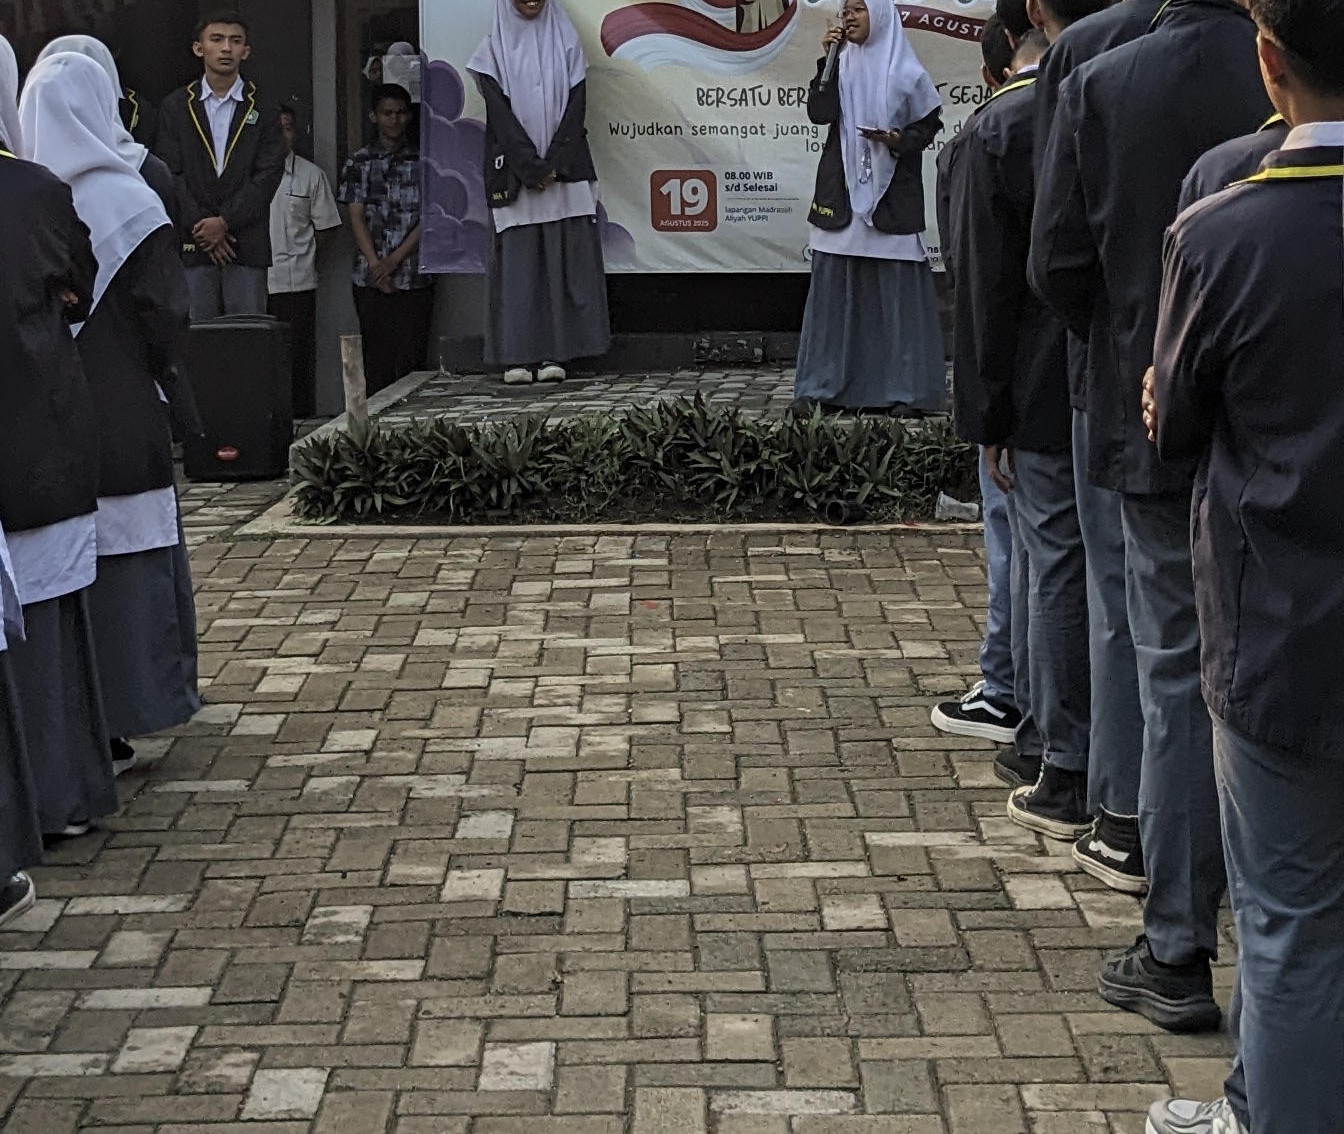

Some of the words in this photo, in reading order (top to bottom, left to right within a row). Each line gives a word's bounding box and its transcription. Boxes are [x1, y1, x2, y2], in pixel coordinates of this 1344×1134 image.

[917, 13, 984, 38] AGUST
[696, 84, 772, 108] BERSATU
[608, 121, 684, 140] Wujudkan
[691, 122, 767, 140] semangat
[772, 123, 820, 140] juang
[724, 171, 752, 181] 08.00
[724, 182, 741, 192] s/d
[743, 182, 778, 192] Selesai
[659, 178, 709, 216] 19
[659, 219, 692, 227] AGUSTUS
